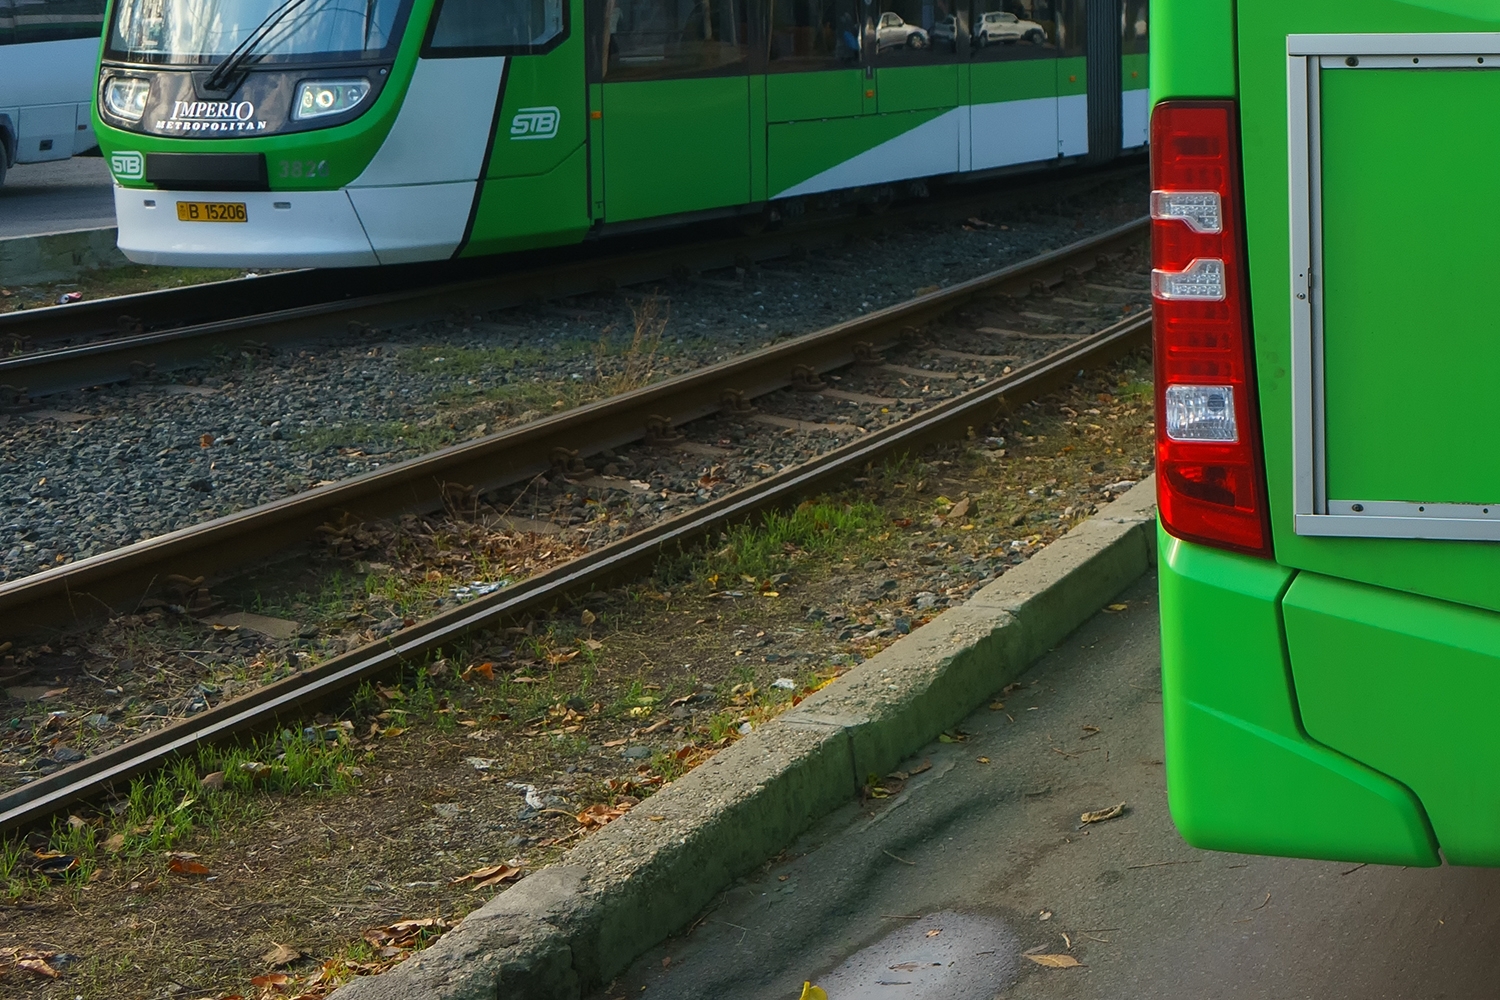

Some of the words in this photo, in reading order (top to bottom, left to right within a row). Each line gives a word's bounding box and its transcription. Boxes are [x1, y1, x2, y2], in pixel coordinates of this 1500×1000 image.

[170, 101, 254, 121] IMPERIO
[156, 120, 267, 131] METROPOLITAN
[510, 112, 556, 134] STB
[189, 203, 200, 219] B
[205, 204, 245, 219] 15206
